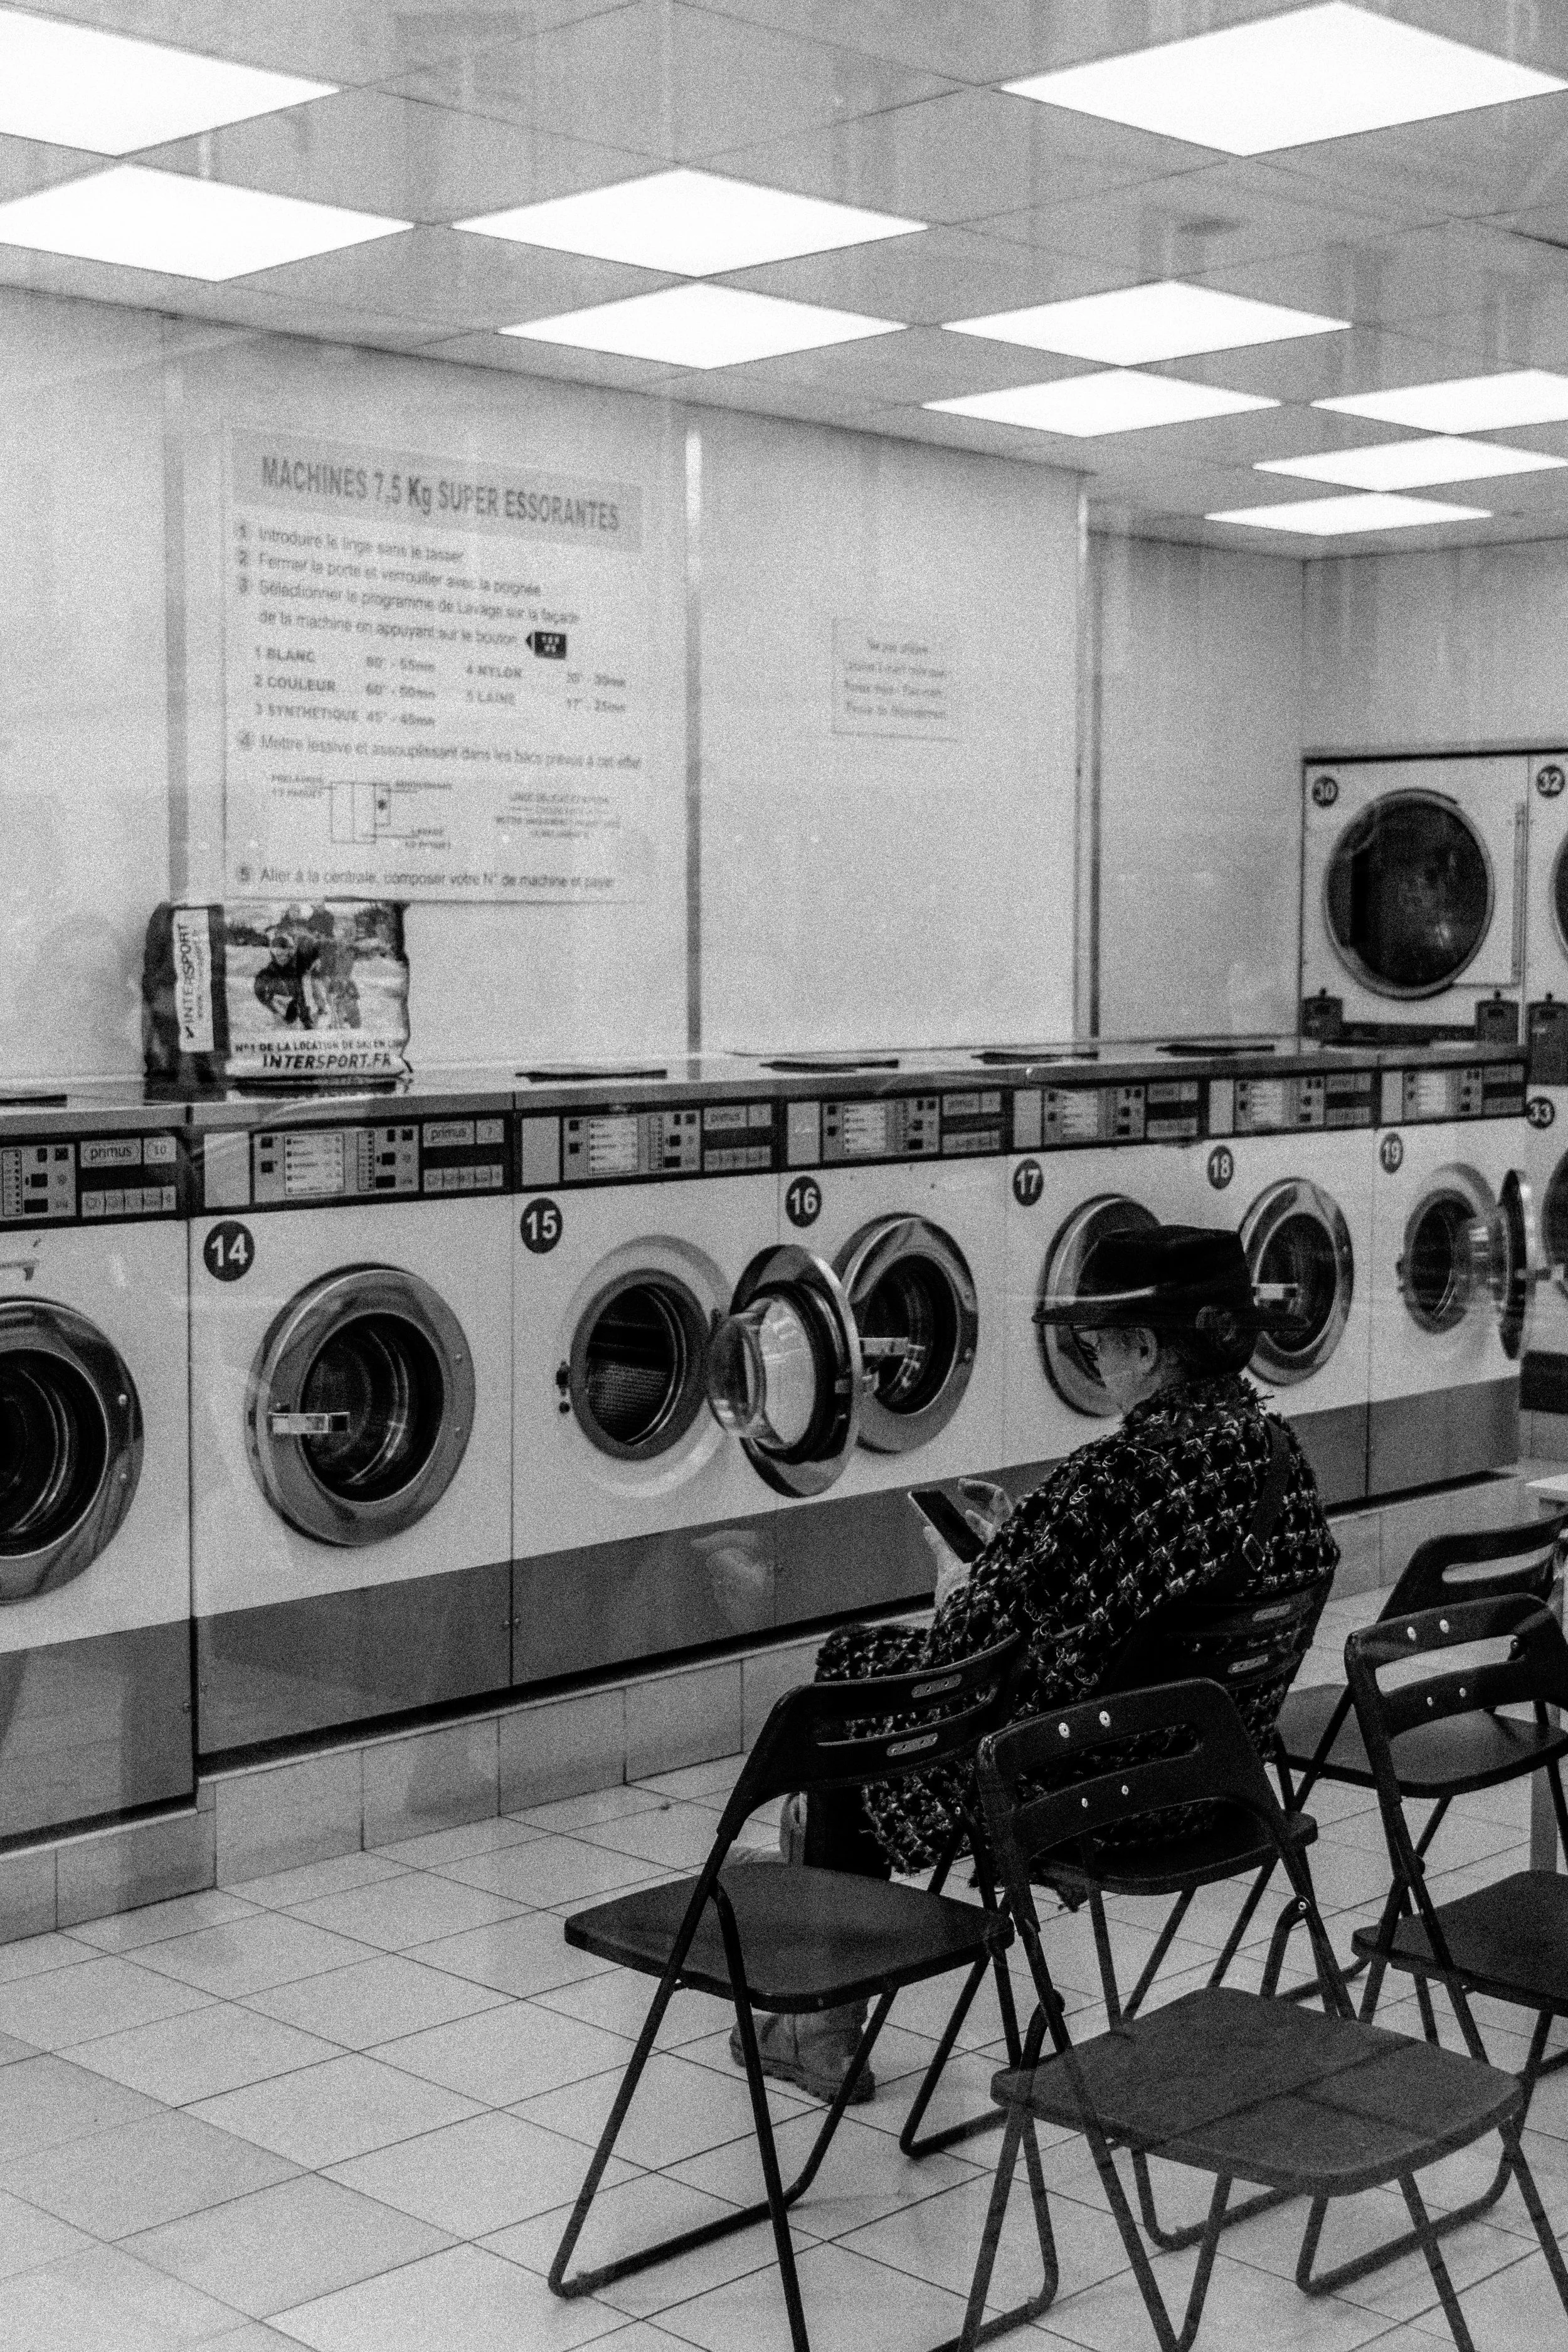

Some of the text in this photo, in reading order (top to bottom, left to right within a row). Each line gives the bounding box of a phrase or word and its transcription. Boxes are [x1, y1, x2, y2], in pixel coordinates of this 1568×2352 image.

[262, 455, 367, 501] MACHINES
[408, 475, 432, 516] Kg
[438, 479, 499, 517] SUPER
[504, 488, 620, 532] ESSORANTES
[266, 647, 315, 664] BLANC
[267, 675, 336, 692] COULEUR
[1539, 771, 1561, 792] 32
[177, 923, 195, 1023] INTERSPORT
[277, 1041, 291, 1052] LA
[1528, 1103, 1550, 1123] 33
[1383, 1140, 1401, 1165] 19
[1210, 1156, 1231, 1179] 18
[1017, 1168, 1039, 1195] 17
[790, 1187, 817, 1216] 16
[526, 1209, 558, 1241] 15
[210, 1232, 249, 1268] 14
